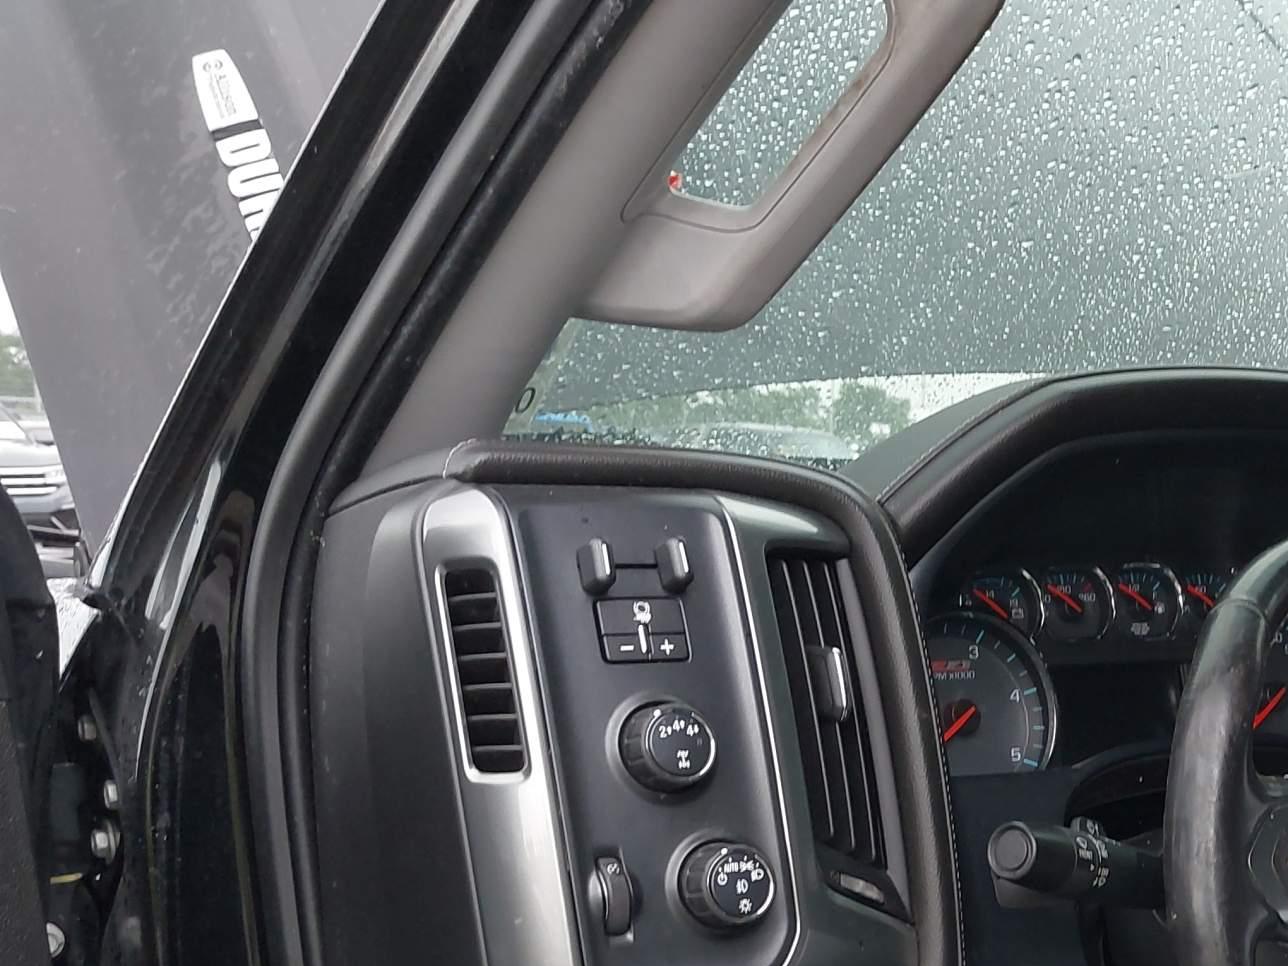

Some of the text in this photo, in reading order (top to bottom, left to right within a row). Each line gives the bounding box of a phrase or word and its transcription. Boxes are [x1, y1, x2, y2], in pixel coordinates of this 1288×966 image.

[215, 128, 285, 241] DUR
[968, 645, 979, 659] 3
[1009, 688, 1020, 703] 4
[1010, 747, 1021, 762] 5
